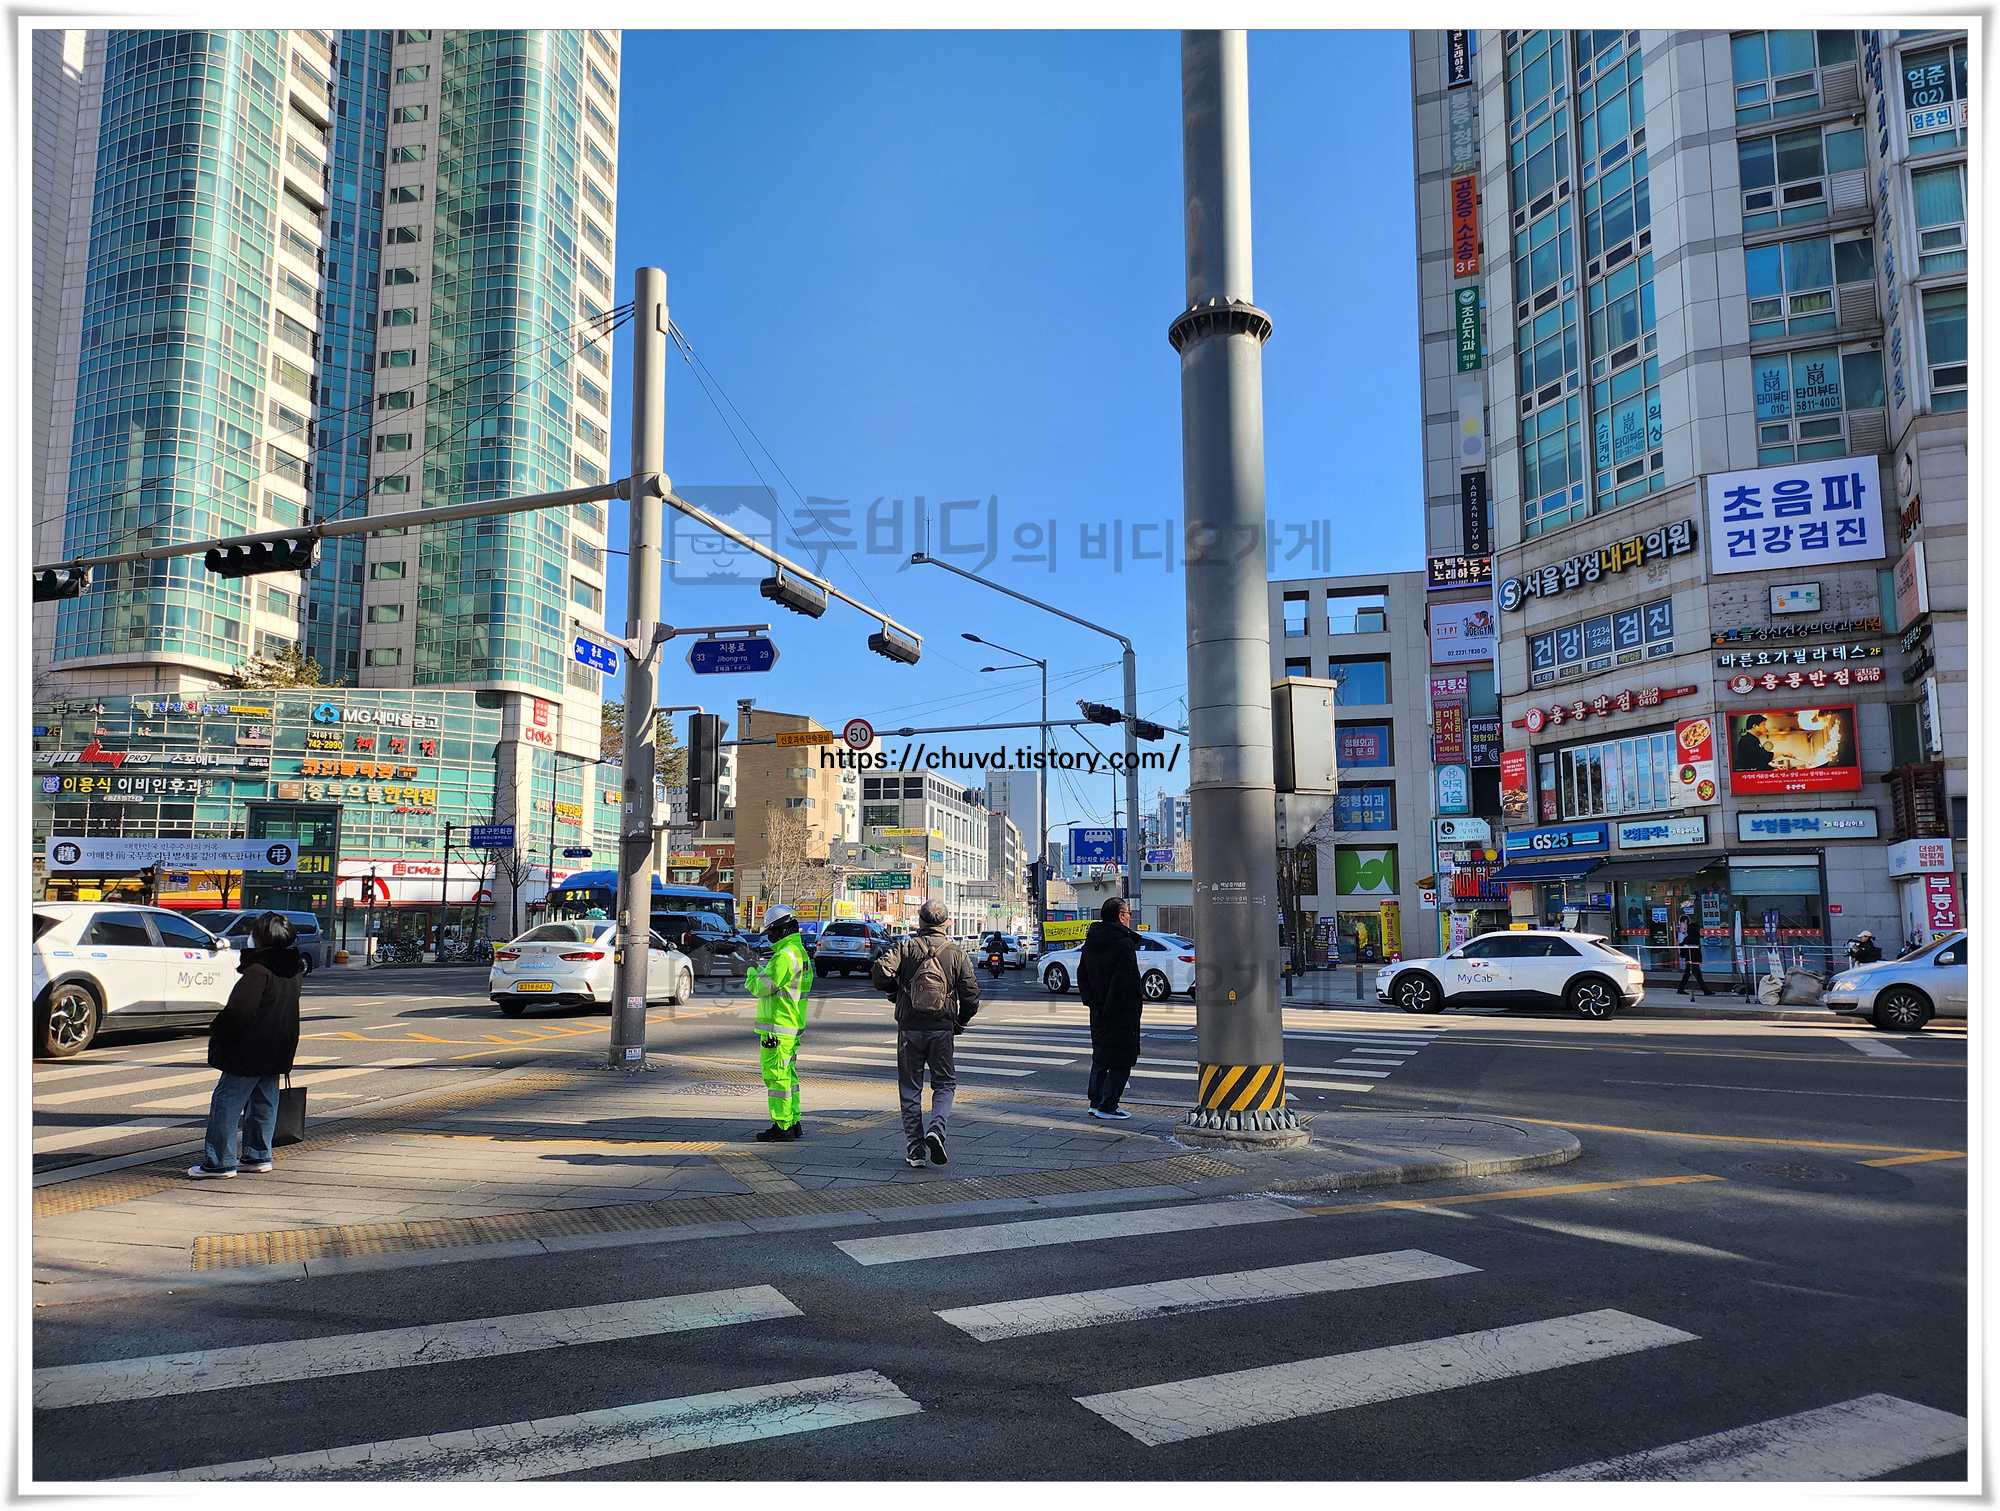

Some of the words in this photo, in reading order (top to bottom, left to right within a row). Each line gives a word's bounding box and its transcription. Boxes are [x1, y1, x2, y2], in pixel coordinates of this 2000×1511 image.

[1912, 87, 1945, 107] (02)
[1456, 259, 1476, 273] 3F
[1461, 307, 1476, 351] 조은치과
[1796, 384, 1839, 399] 타미뷰티
[1796, 396, 1841, 411] 5811-4001
[1722, 472, 1867, 524] 초음파
[1726, 517, 1868, 558] 건강검진
[1523, 520, 1692, 598] 서울삼성내과의원
[1434, 566, 1492, 582] 노래하우스
[1534, 628, 1580, 671] 건강
[1618, 604, 1672, 644] 검진
[719, 642, 746, 653] 지봉로
[695, 653, 706, 663] 33
[759, 651, 769, 660] 29
[1721, 645, 1866, 669] 바른요가필라테스
[1869, 647, 1881, 656] 2F
[1437, 678, 1468, 691] 부동산
[1760, 668, 1849, 689] 홍콩반점
[1551, 689, 1632, 725] 홍콩반점
[525, 727, 553, 747] 다이소
[849, 728, 869, 742] 50
[171, 755, 220, 767] 스포애니
[62, 777, 113, 793] 이용식
[117, 778, 203, 794] 이비인후과
[1442, 790, 1463, 804] 1층
[1532, 833, 1570, 850] GS25
[406, 866, 442, 876] 다이소
[565, 889, 591, 901] 271
[1929, 875, 1957, 928] 부동산
[177, 971, 194, 988] My
[194, 970, 214, 986] Cab
[1457, 973, 1472, 985] My
[1473, 973, 1493, 983] Cab
